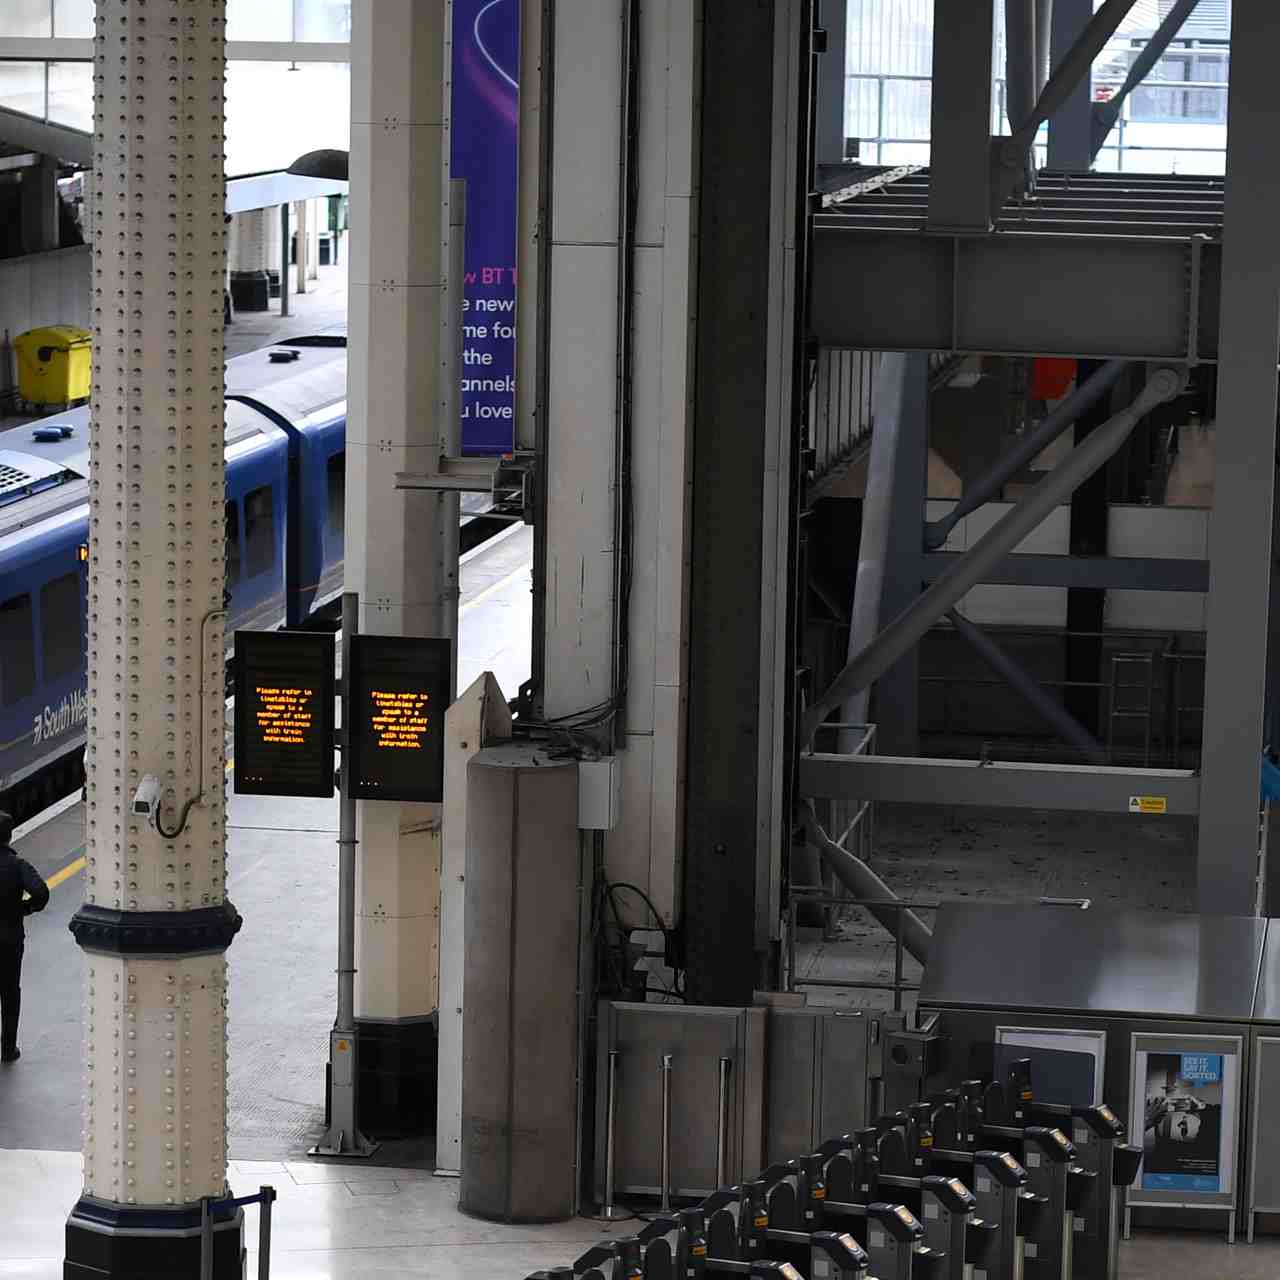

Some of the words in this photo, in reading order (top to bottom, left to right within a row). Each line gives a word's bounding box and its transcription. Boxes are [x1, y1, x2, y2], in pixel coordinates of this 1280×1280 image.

[482, 267, 505, 285] BT
[475, 298, 515, 312] new
[462, 347, 493, 366] the
[43, 697, 70, 739] South
